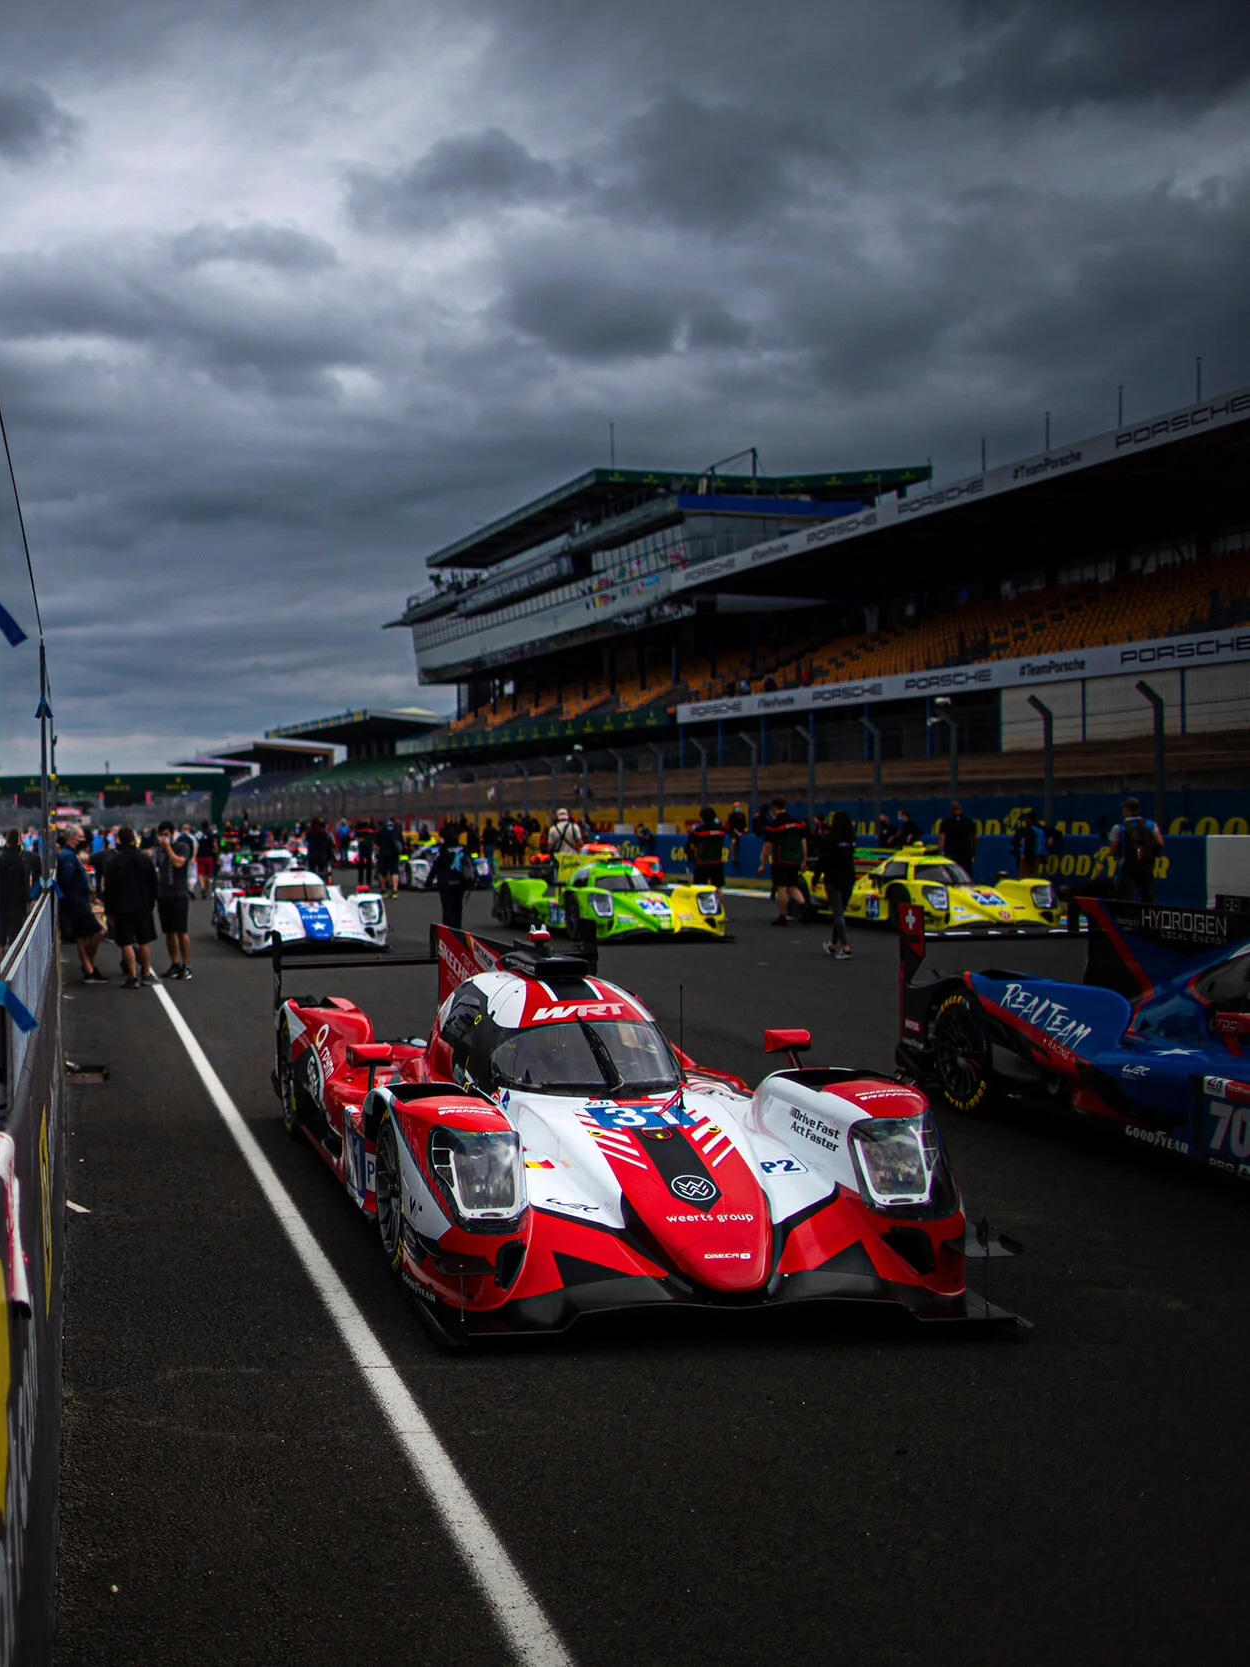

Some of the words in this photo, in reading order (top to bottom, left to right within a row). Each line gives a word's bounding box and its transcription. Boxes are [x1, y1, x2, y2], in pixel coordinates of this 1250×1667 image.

[1115, 394, 1250, 450] PORSCHE
[1013, 450, 1082, 481] #TeamPorsche
[897, 478, 985, 515] PORSCHE
[806, 512, 878, 544] PORSCHE
[1120, 635, 1250, 665] PORSCHE
[905, 668, 993, 691] PORSCHE
[1019, 657, 1086, 678] #TeamPorsche
[812, 682, 883, 703] PORSCHE
[1141, 908, 1228, 937] HYDROGEN
[531, 1002, 626, 1021] WRT
[940, 993, 963, 1014] EAGLE
[1048, 1039, 1071, 1060] RACING
[1122, 1063, 1151, 1077] WEC
[604, 1104, 680, 1124] 31
[795, 1107, 816, 1129] Drive
[816, 1122, 841, 1141] Fast
[790, 1121, 806, 1138] Act
[805, 1127, 840, 1153] Faster
[1125, 1124, 1189, 1154] GOODYEAR
[1209, 1100, 1250, 1159] 70
[759, 1159, 801, 1174] P2
[665, 1213, 714, 1223] weerts
[716, 1213, 754, 1223] group
